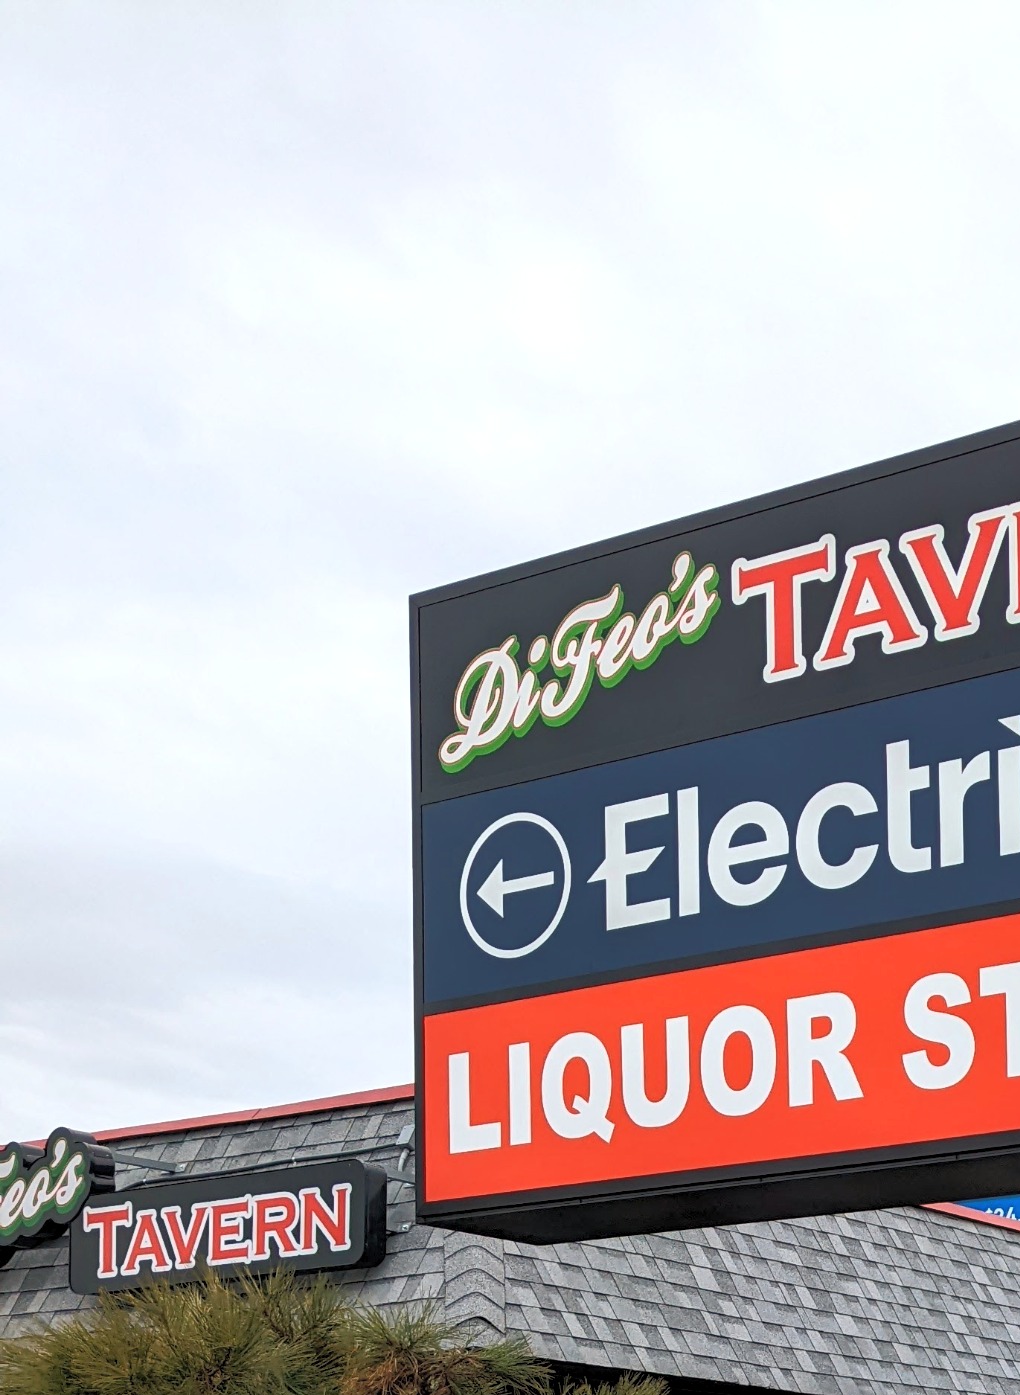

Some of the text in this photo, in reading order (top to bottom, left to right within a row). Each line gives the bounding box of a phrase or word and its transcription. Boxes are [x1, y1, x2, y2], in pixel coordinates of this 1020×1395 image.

[439, 551, 720, 773] DiFeo's
[447, 992, 864, 1155] LIQUOR
[83, 1183, 352, 1278] TAVERN
